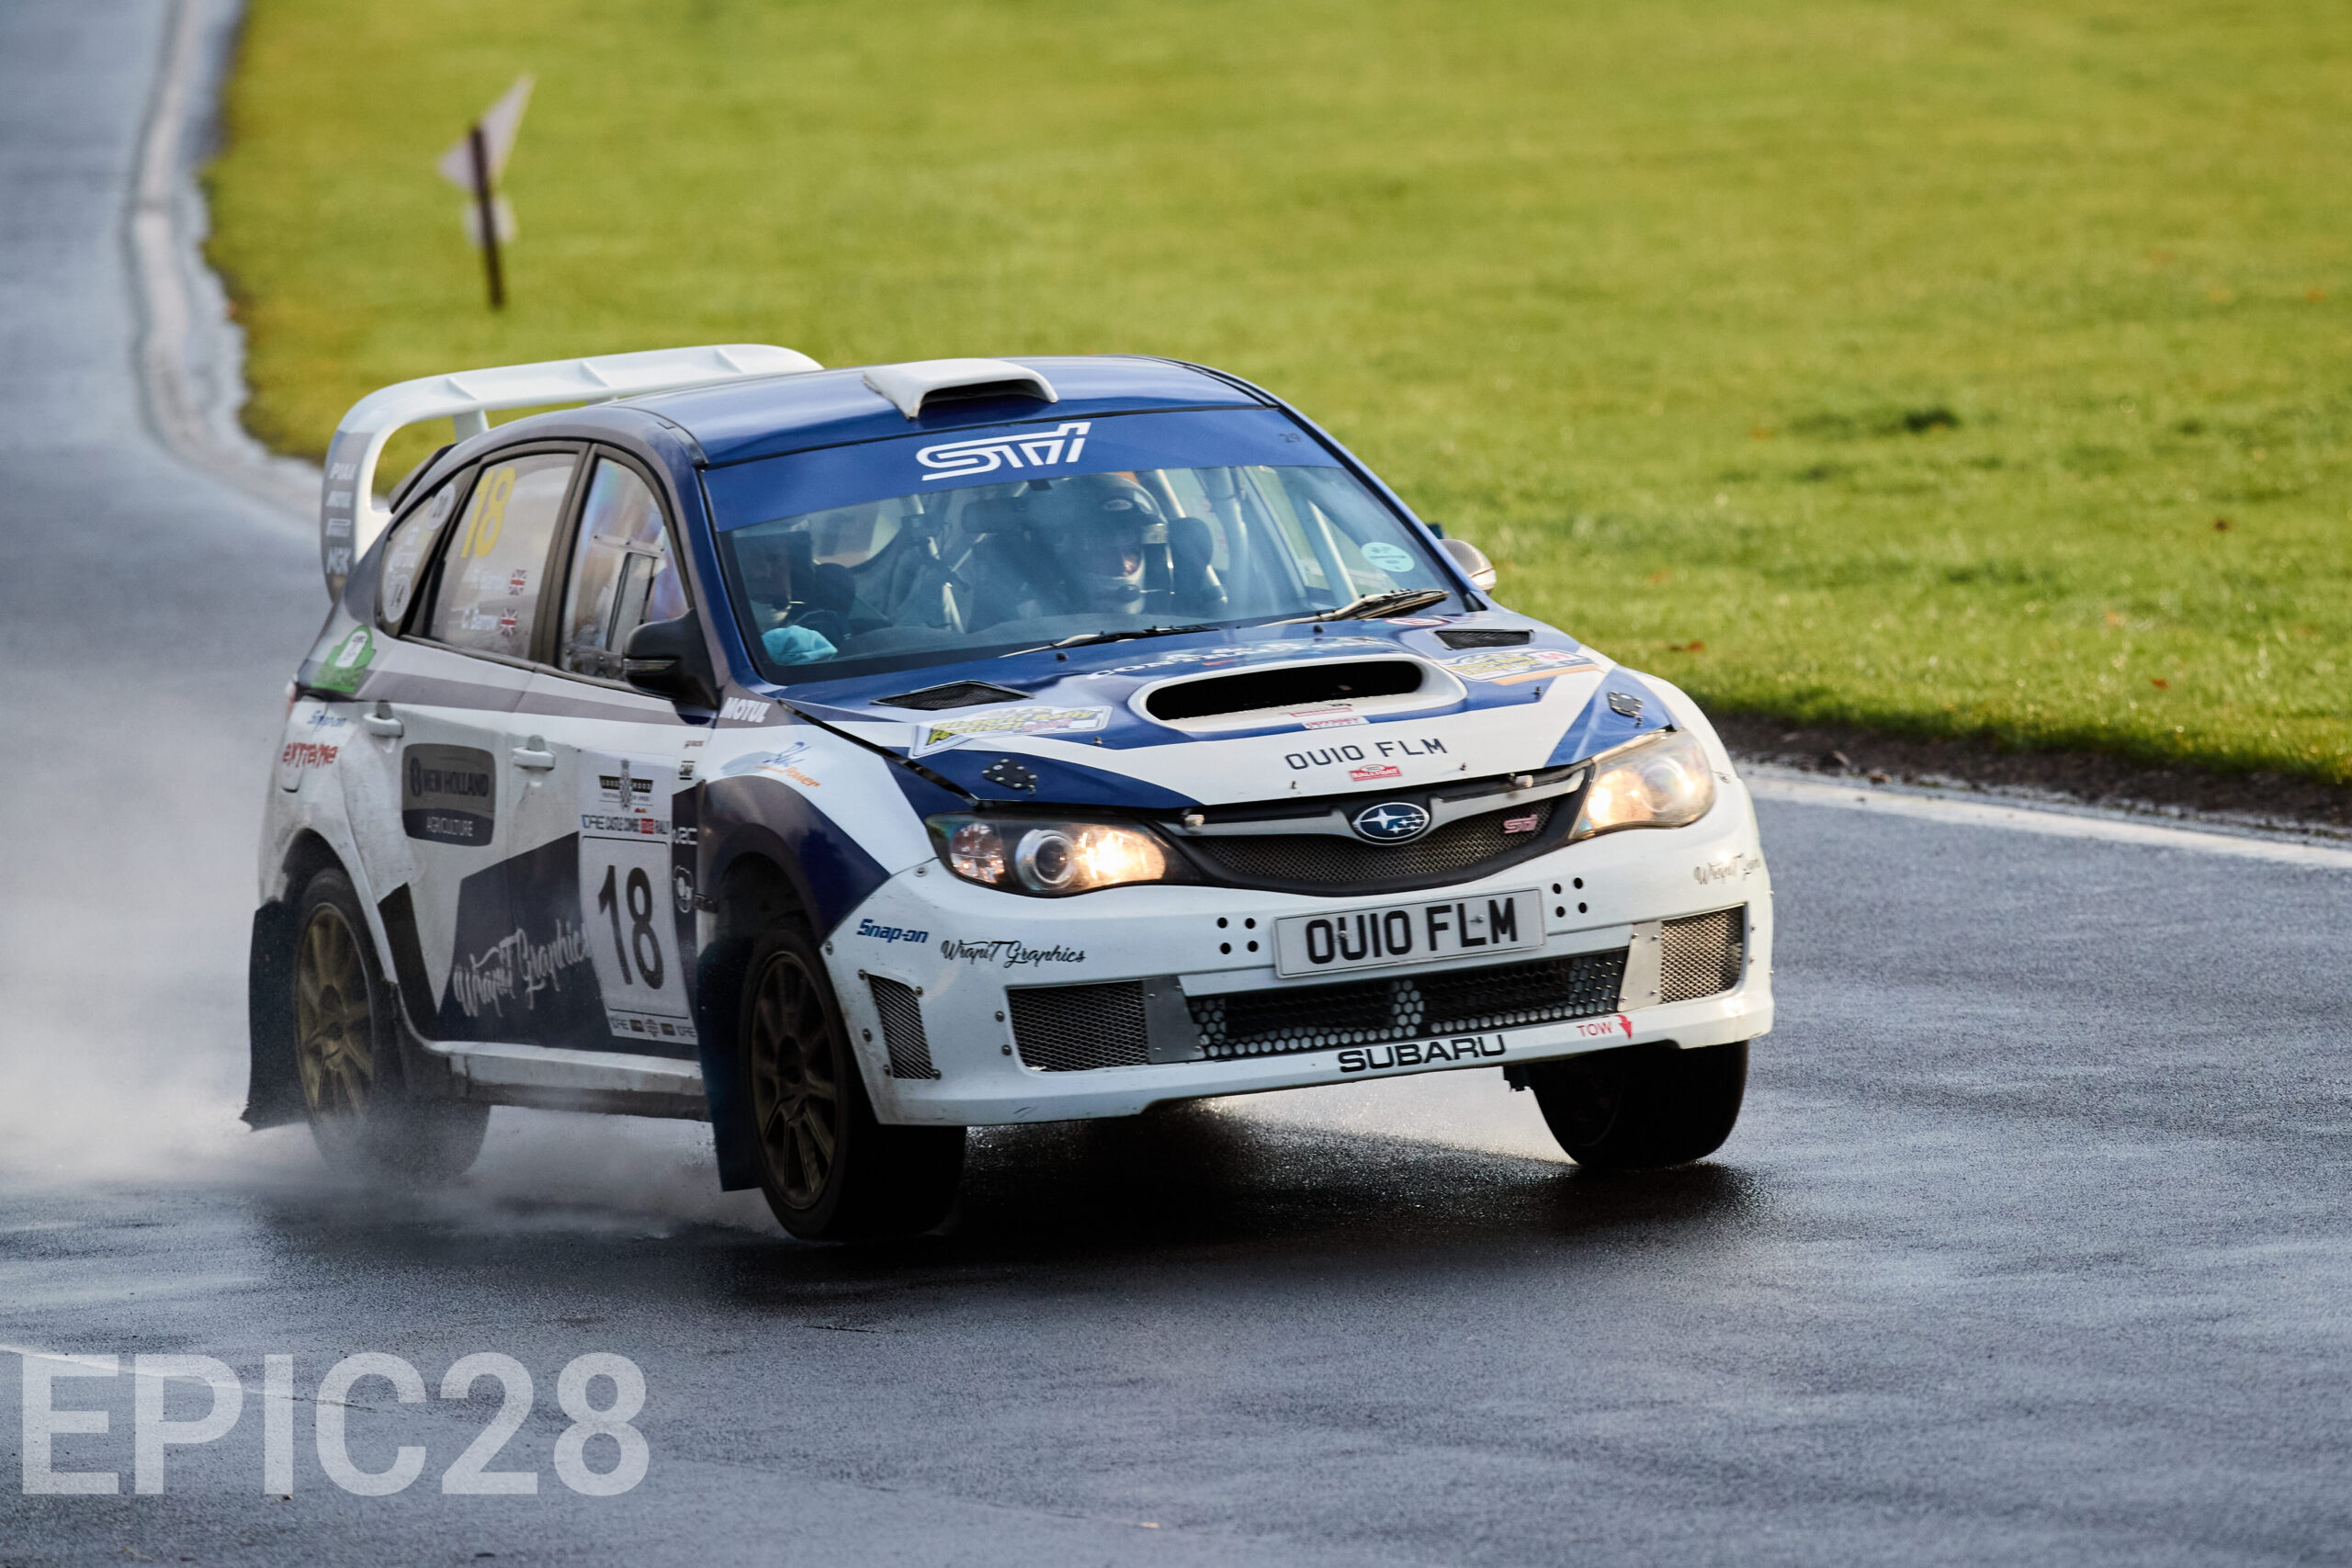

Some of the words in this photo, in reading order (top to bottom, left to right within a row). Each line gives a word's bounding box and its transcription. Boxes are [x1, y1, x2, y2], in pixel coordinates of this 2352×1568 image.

[461, 467, 516, 558] 18
[719, 696, 772, 724] MOTUL
[1375, 738, 1449, 758] FLM
[597, 864, 664, 989] 18
[856, 919, 930, 943] Snap-on
[1426, 897, 1519, 952] FLM
[1003, 940, 1087, 969] Graphics
[1577, 1021, 1612, 1038] TOW
[1338, 1034, 1507, 1073] SUBARU
